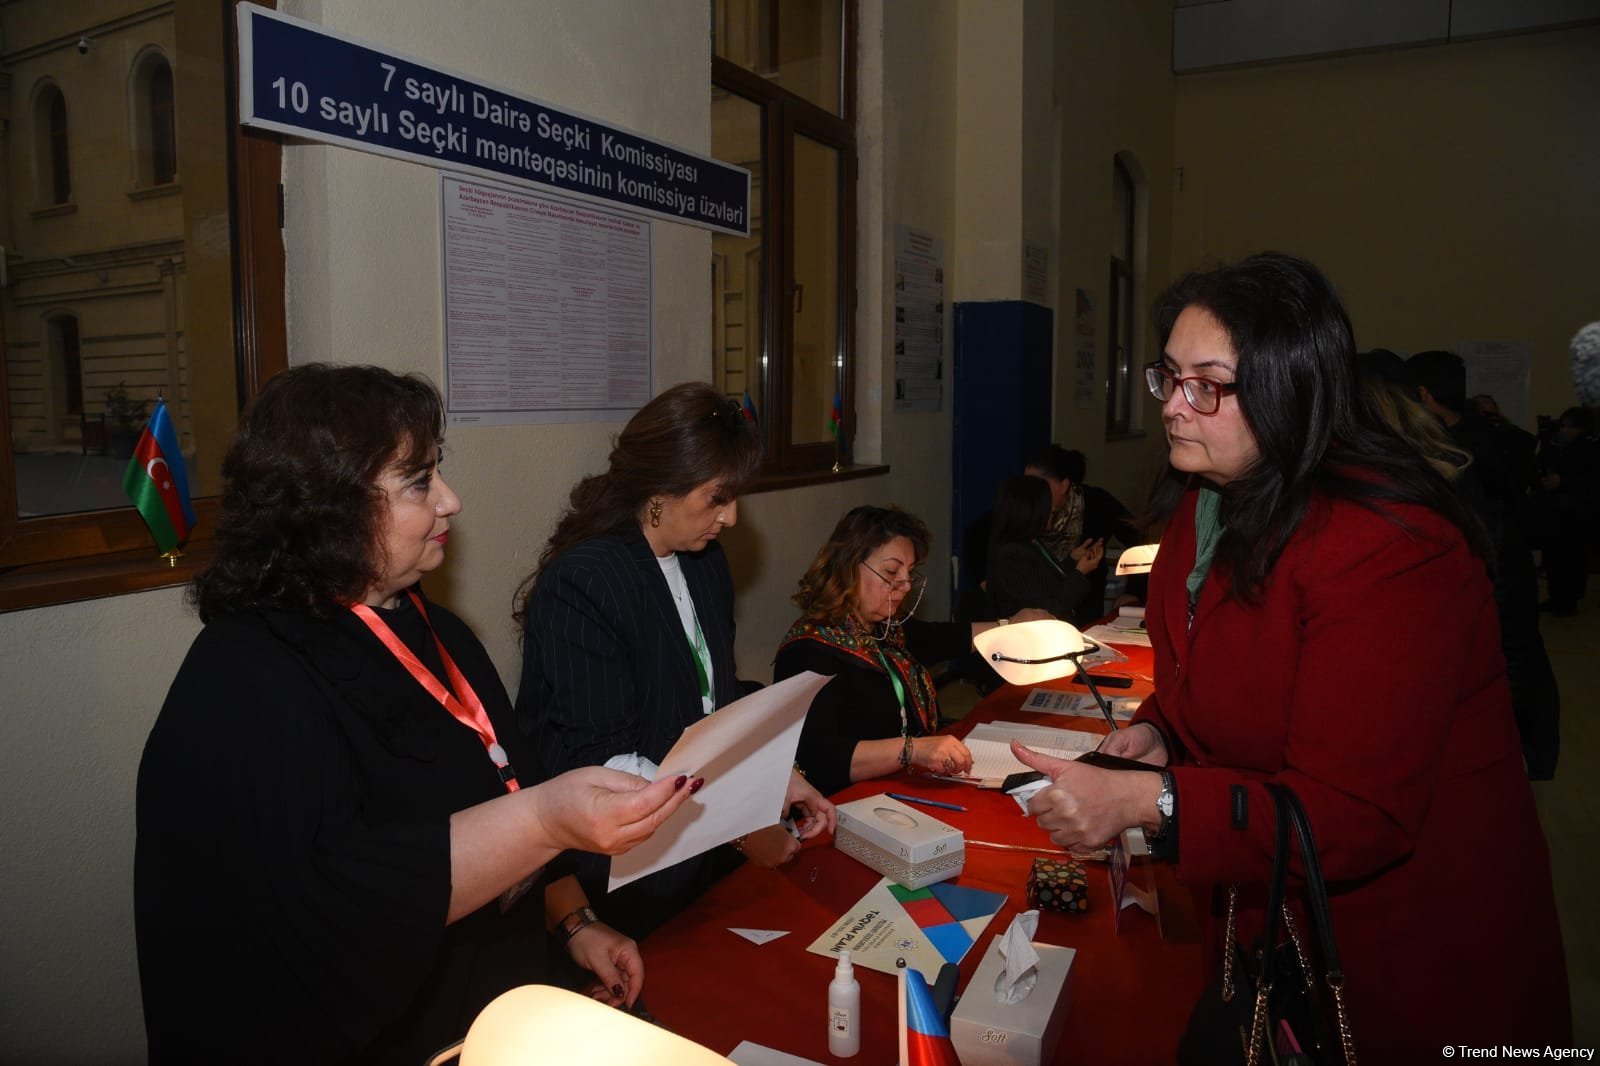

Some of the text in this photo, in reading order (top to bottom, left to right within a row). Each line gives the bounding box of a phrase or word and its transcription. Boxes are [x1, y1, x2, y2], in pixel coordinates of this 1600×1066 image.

[272, 76, 744, 225] 10 saylı Seçki məntəqəsinin komissiya üzvləri
[380, 62, 698, 183] 7 saylı Dairə Seçki Komissiyası
[981, 1029, 1007, 1045] Soft
